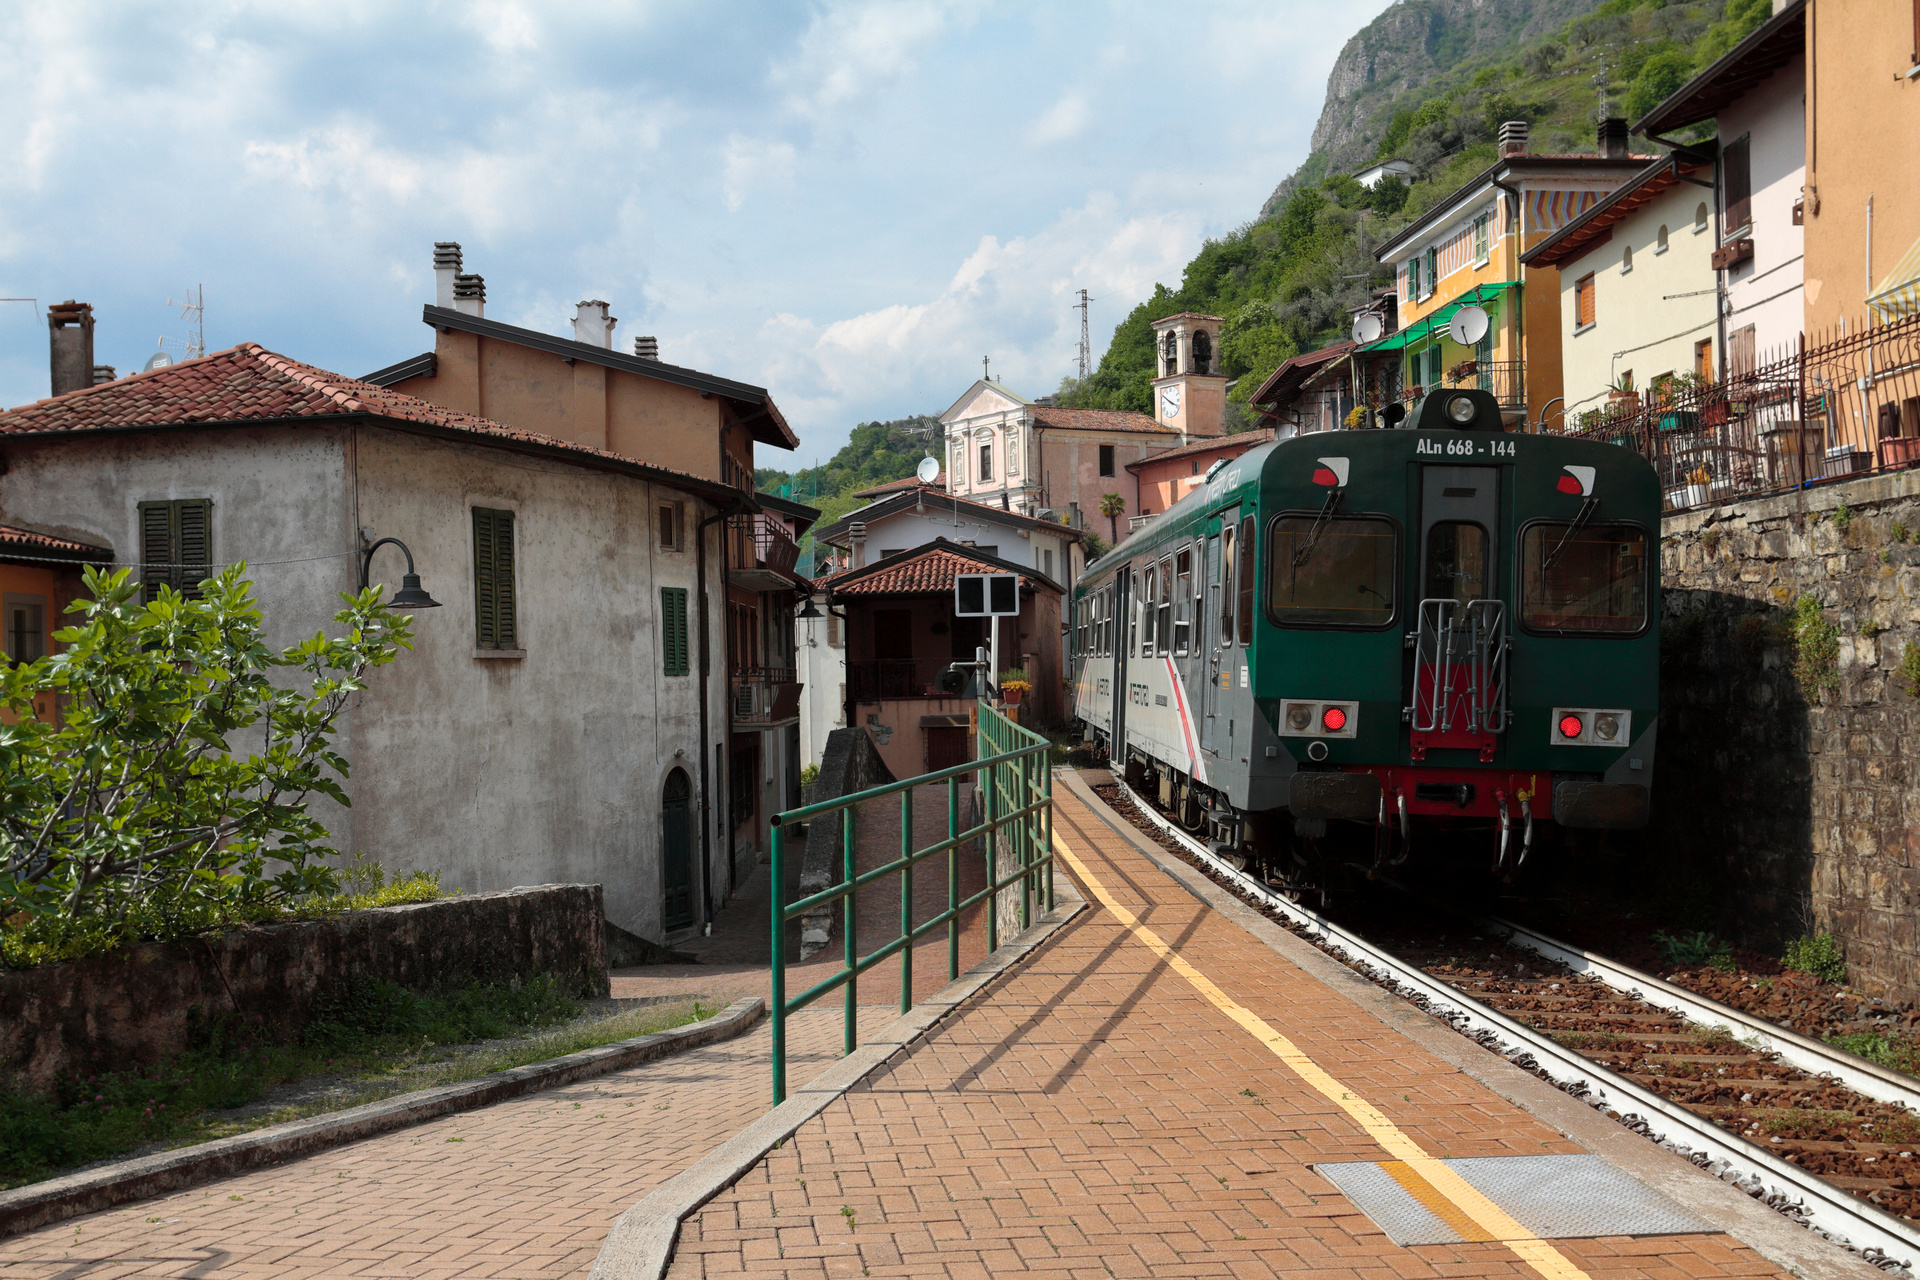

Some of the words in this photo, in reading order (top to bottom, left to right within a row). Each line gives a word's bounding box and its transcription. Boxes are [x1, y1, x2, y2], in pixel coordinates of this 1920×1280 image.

[1416, 438, 1442, 455] ALn
[1446, 439, 1473, 456] 668
[1490, 440, 1516, 457] 144
